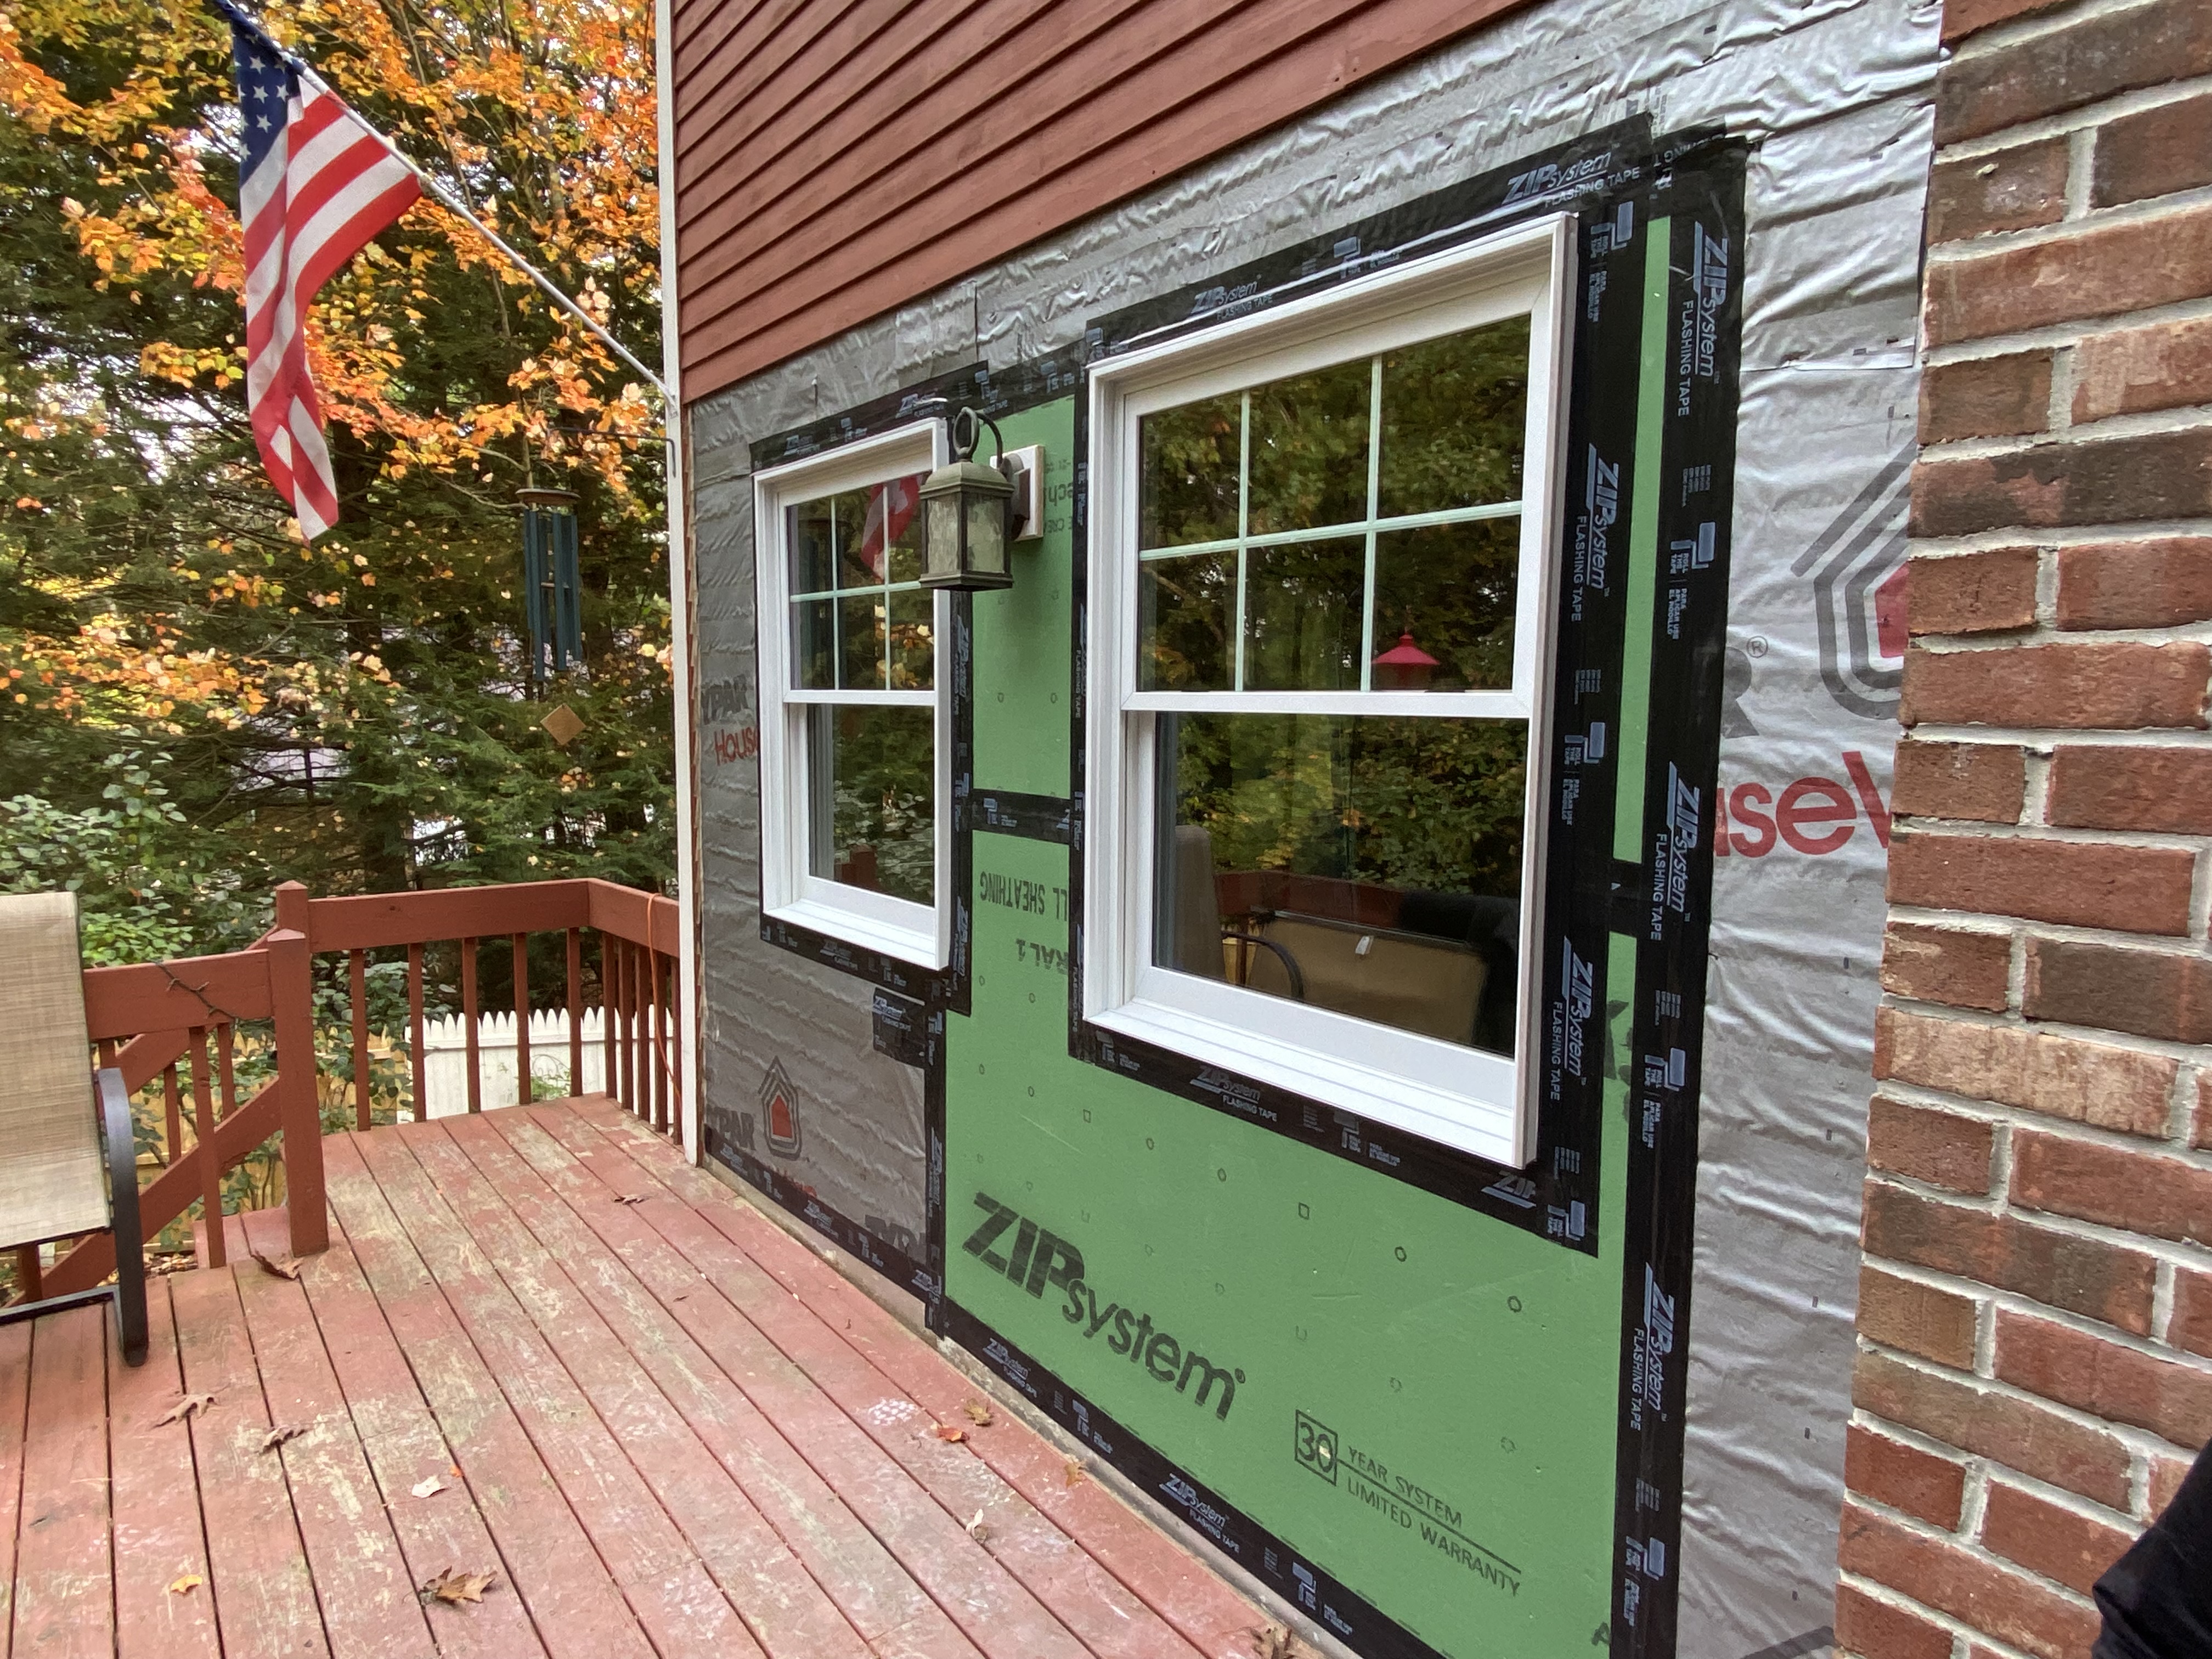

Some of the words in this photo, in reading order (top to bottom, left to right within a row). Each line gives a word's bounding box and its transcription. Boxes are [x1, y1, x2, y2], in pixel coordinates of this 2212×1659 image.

[1544, 179, 1604, 208] FLASHING
[1607, 167, 1640, 187] TAPE
[1679, 300, 1694, 375] FLASHING
[1678, 377, 1692, 417] TAPE
[1573, 516, 1587, 584] FLASHING
[1571, 586, 1583, 622] TAPE
[1652, 833, 1667, 903] FLASHING
[980, 871, 1046, 915] SHEATHING
[1650, 905, 1663, 941] TAPE
[1551, 1001, 1562, 1066] FLASHING
[1550, 1069, 1561, 1101] TAPE
[1258, 1107, 1278, 1122] TAPE
[1632, 1328, 1645, 1392] FLASHING
[1629, 1397, 1641, 1431] TAPE
[1298, 1422, 1333, 1472] 30
[1348, 1446, 1387, 1482] YEAR
[1395, 1476, 1463, 1528] SYSTEM
[1222, 1534, 1240, 1554] TAPE
[1347, 1476, 1412, 1529] LIMITED
[1420, 1522, 1520, 1596] WARRANTY
